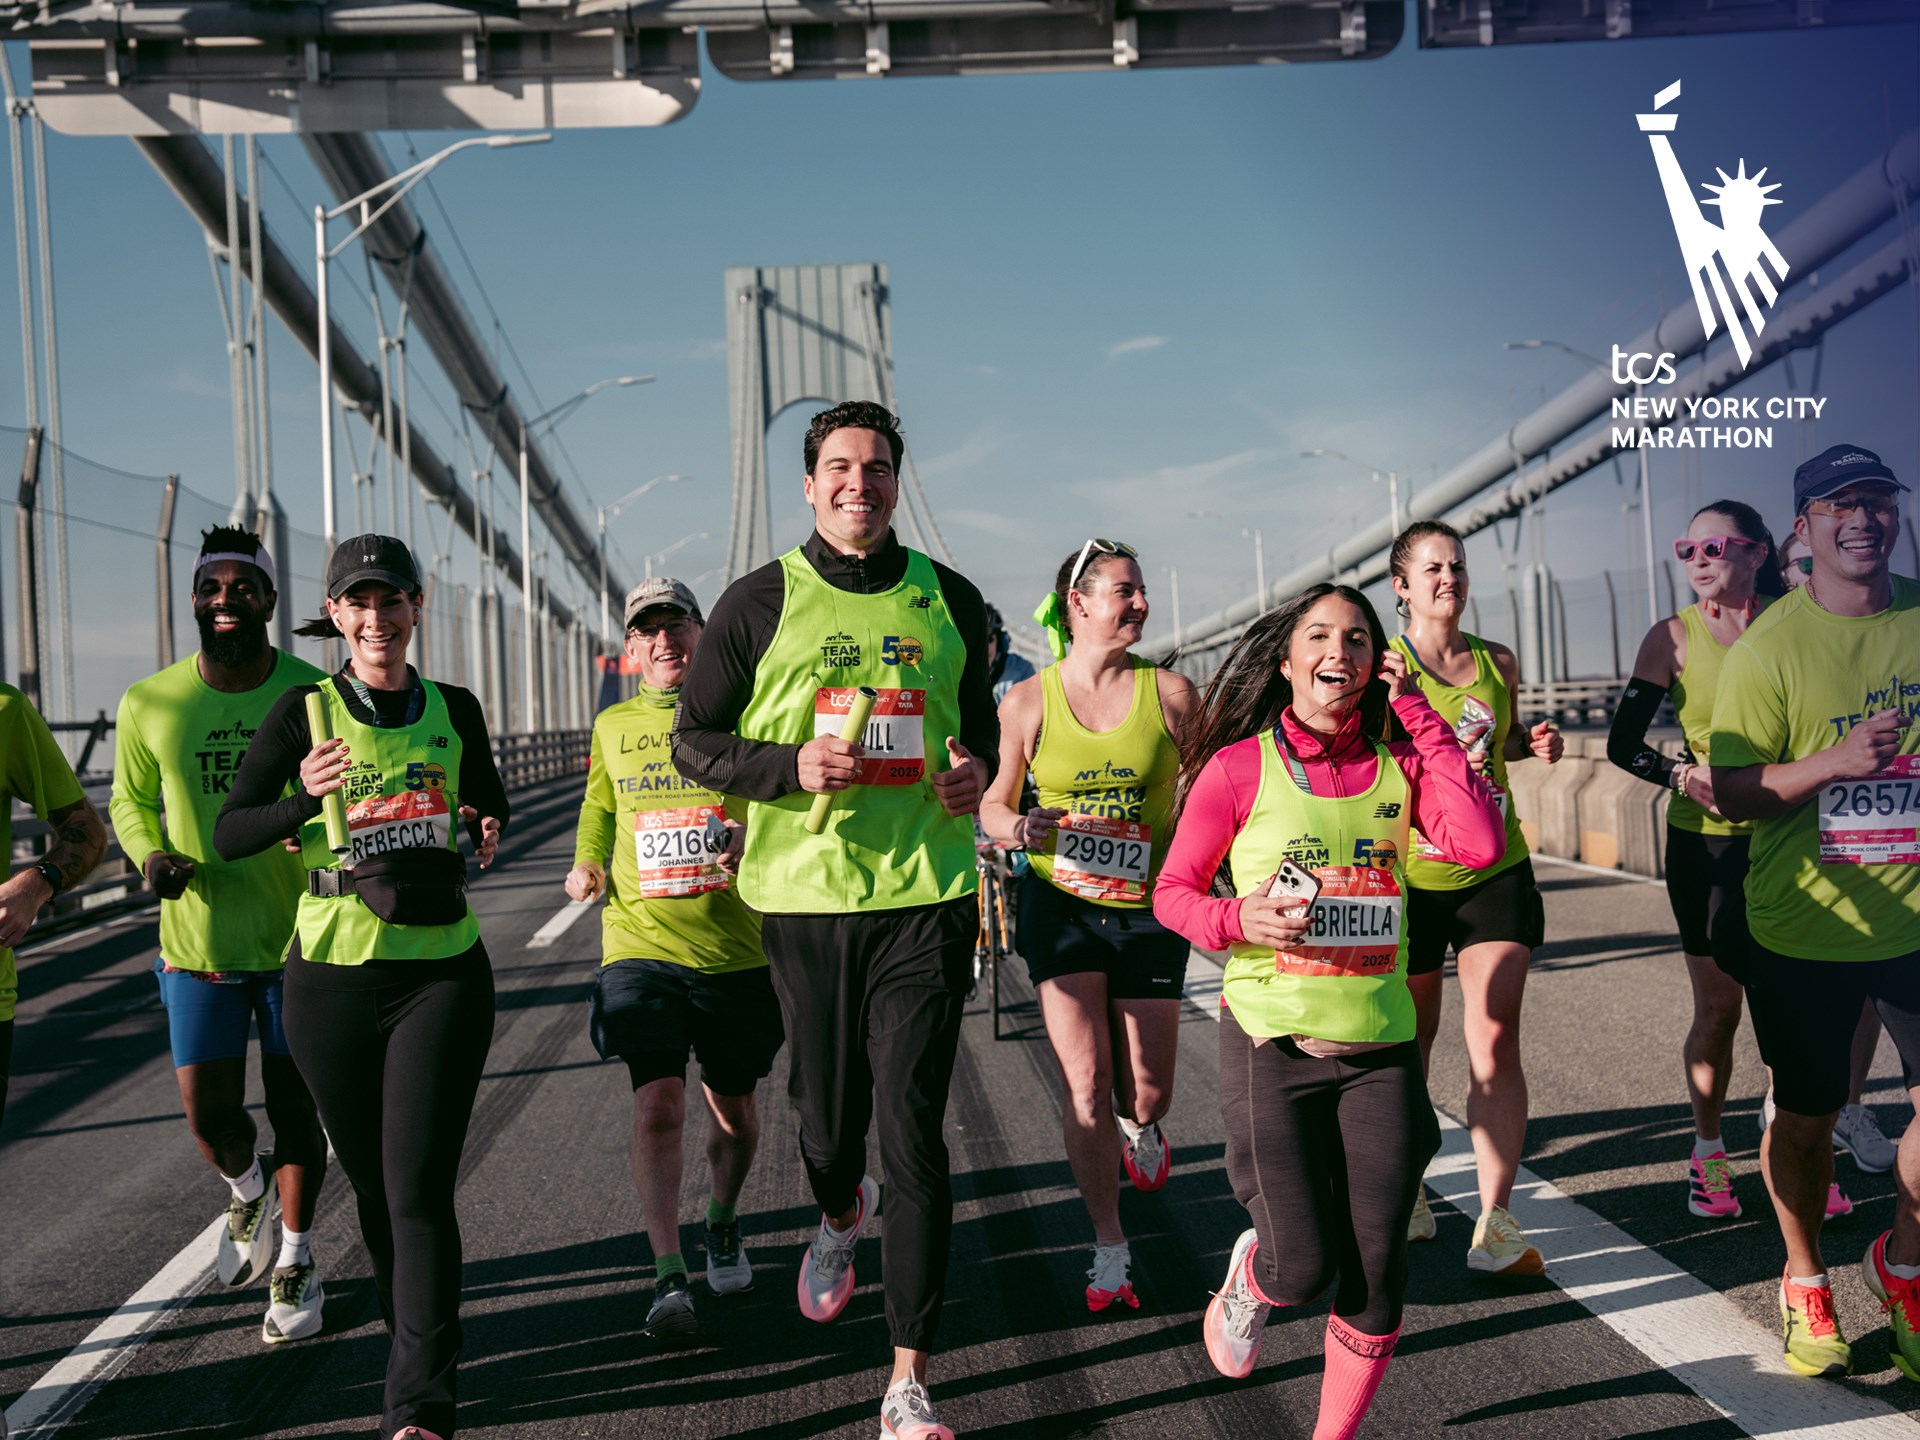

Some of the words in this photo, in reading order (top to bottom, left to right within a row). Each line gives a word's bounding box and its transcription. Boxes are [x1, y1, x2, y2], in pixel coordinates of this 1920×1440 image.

[821, 645, 860, 656] TEAM
[829, 656, 861, 668] KIDS
[890, 767, 919, 777] 2025
[345, 773, 384, 788] TEAM
[617, 775, 671, 794] TEAM
[350, 783, 384, 799] KIDS
[1066, 786, 1147, 804] TEAM
[1080, 802, 1142, 822] KIDS
[644, 815, 662, 828] tcs
[352, 822, 436, 860] REBECCA
[1064, 833, 1143, 870] 29912
[1282, 849, 1329, 860] TEAM
[658, 856, 704, 867] JOHANNES
[1361, 954, 1391, 967] 2025
